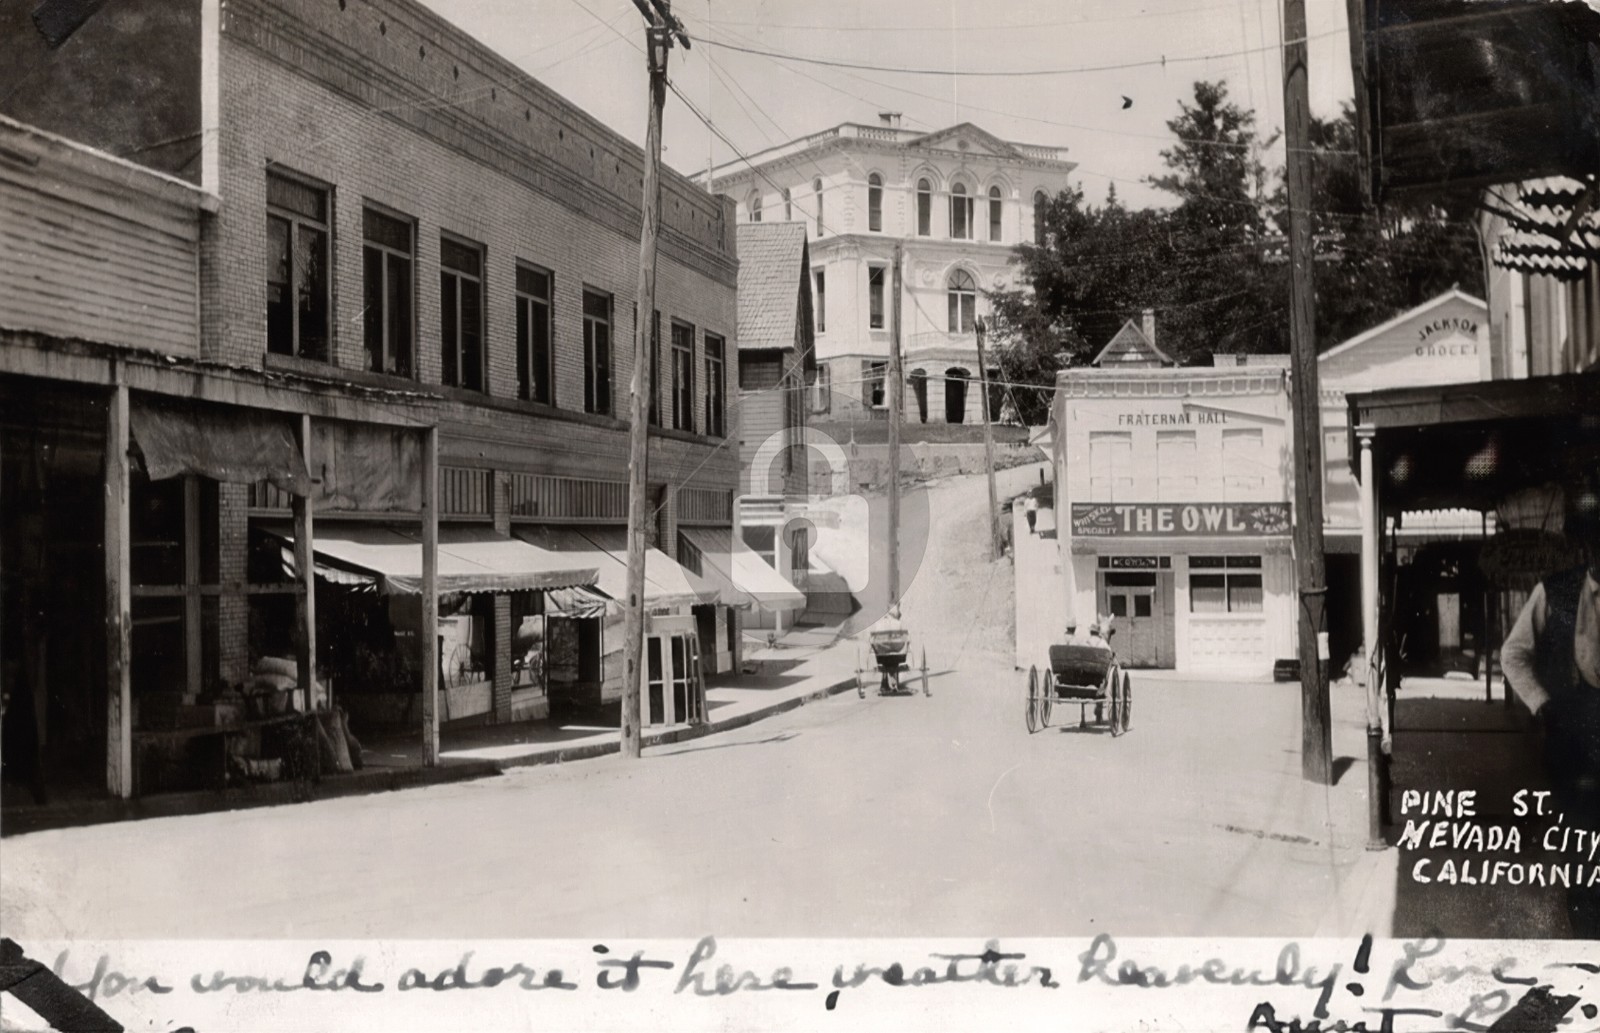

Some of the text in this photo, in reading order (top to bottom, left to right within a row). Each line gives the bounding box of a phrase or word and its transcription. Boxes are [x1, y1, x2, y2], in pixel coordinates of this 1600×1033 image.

[1418, 318, 1478, 341] JACKSON
[1118, 412, 1229, 425] FRATERNAL HALL
[1073, 505, 1111, 527] WHISKEY
[1115, 505, 1246, 532] THE OWL
[190, 950, 384, 995] would
[397, 951, 577, 993] adore
[592, 944, 673, 991] it
